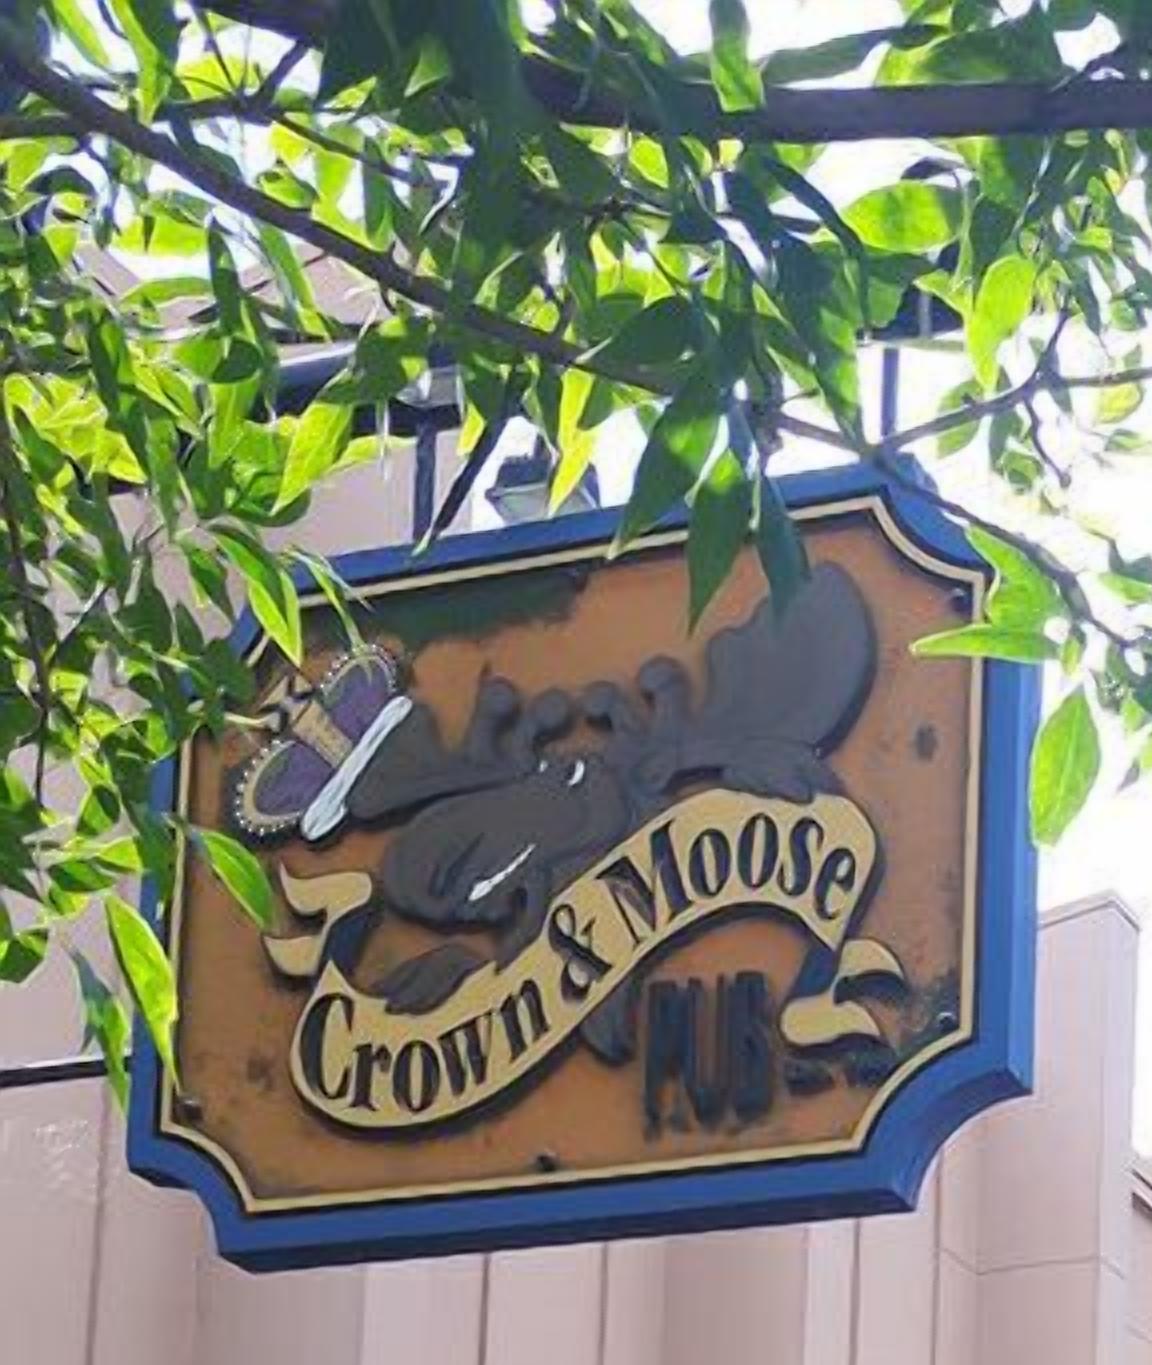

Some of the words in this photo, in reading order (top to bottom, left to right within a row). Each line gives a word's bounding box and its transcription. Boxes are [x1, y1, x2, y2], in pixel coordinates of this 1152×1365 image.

[299, 979, 549, 1113] Crown
[548, 904, 614, 999] &
[597, 818, 858, 948] Moose
[643, 970, 773, 1143] PUB
